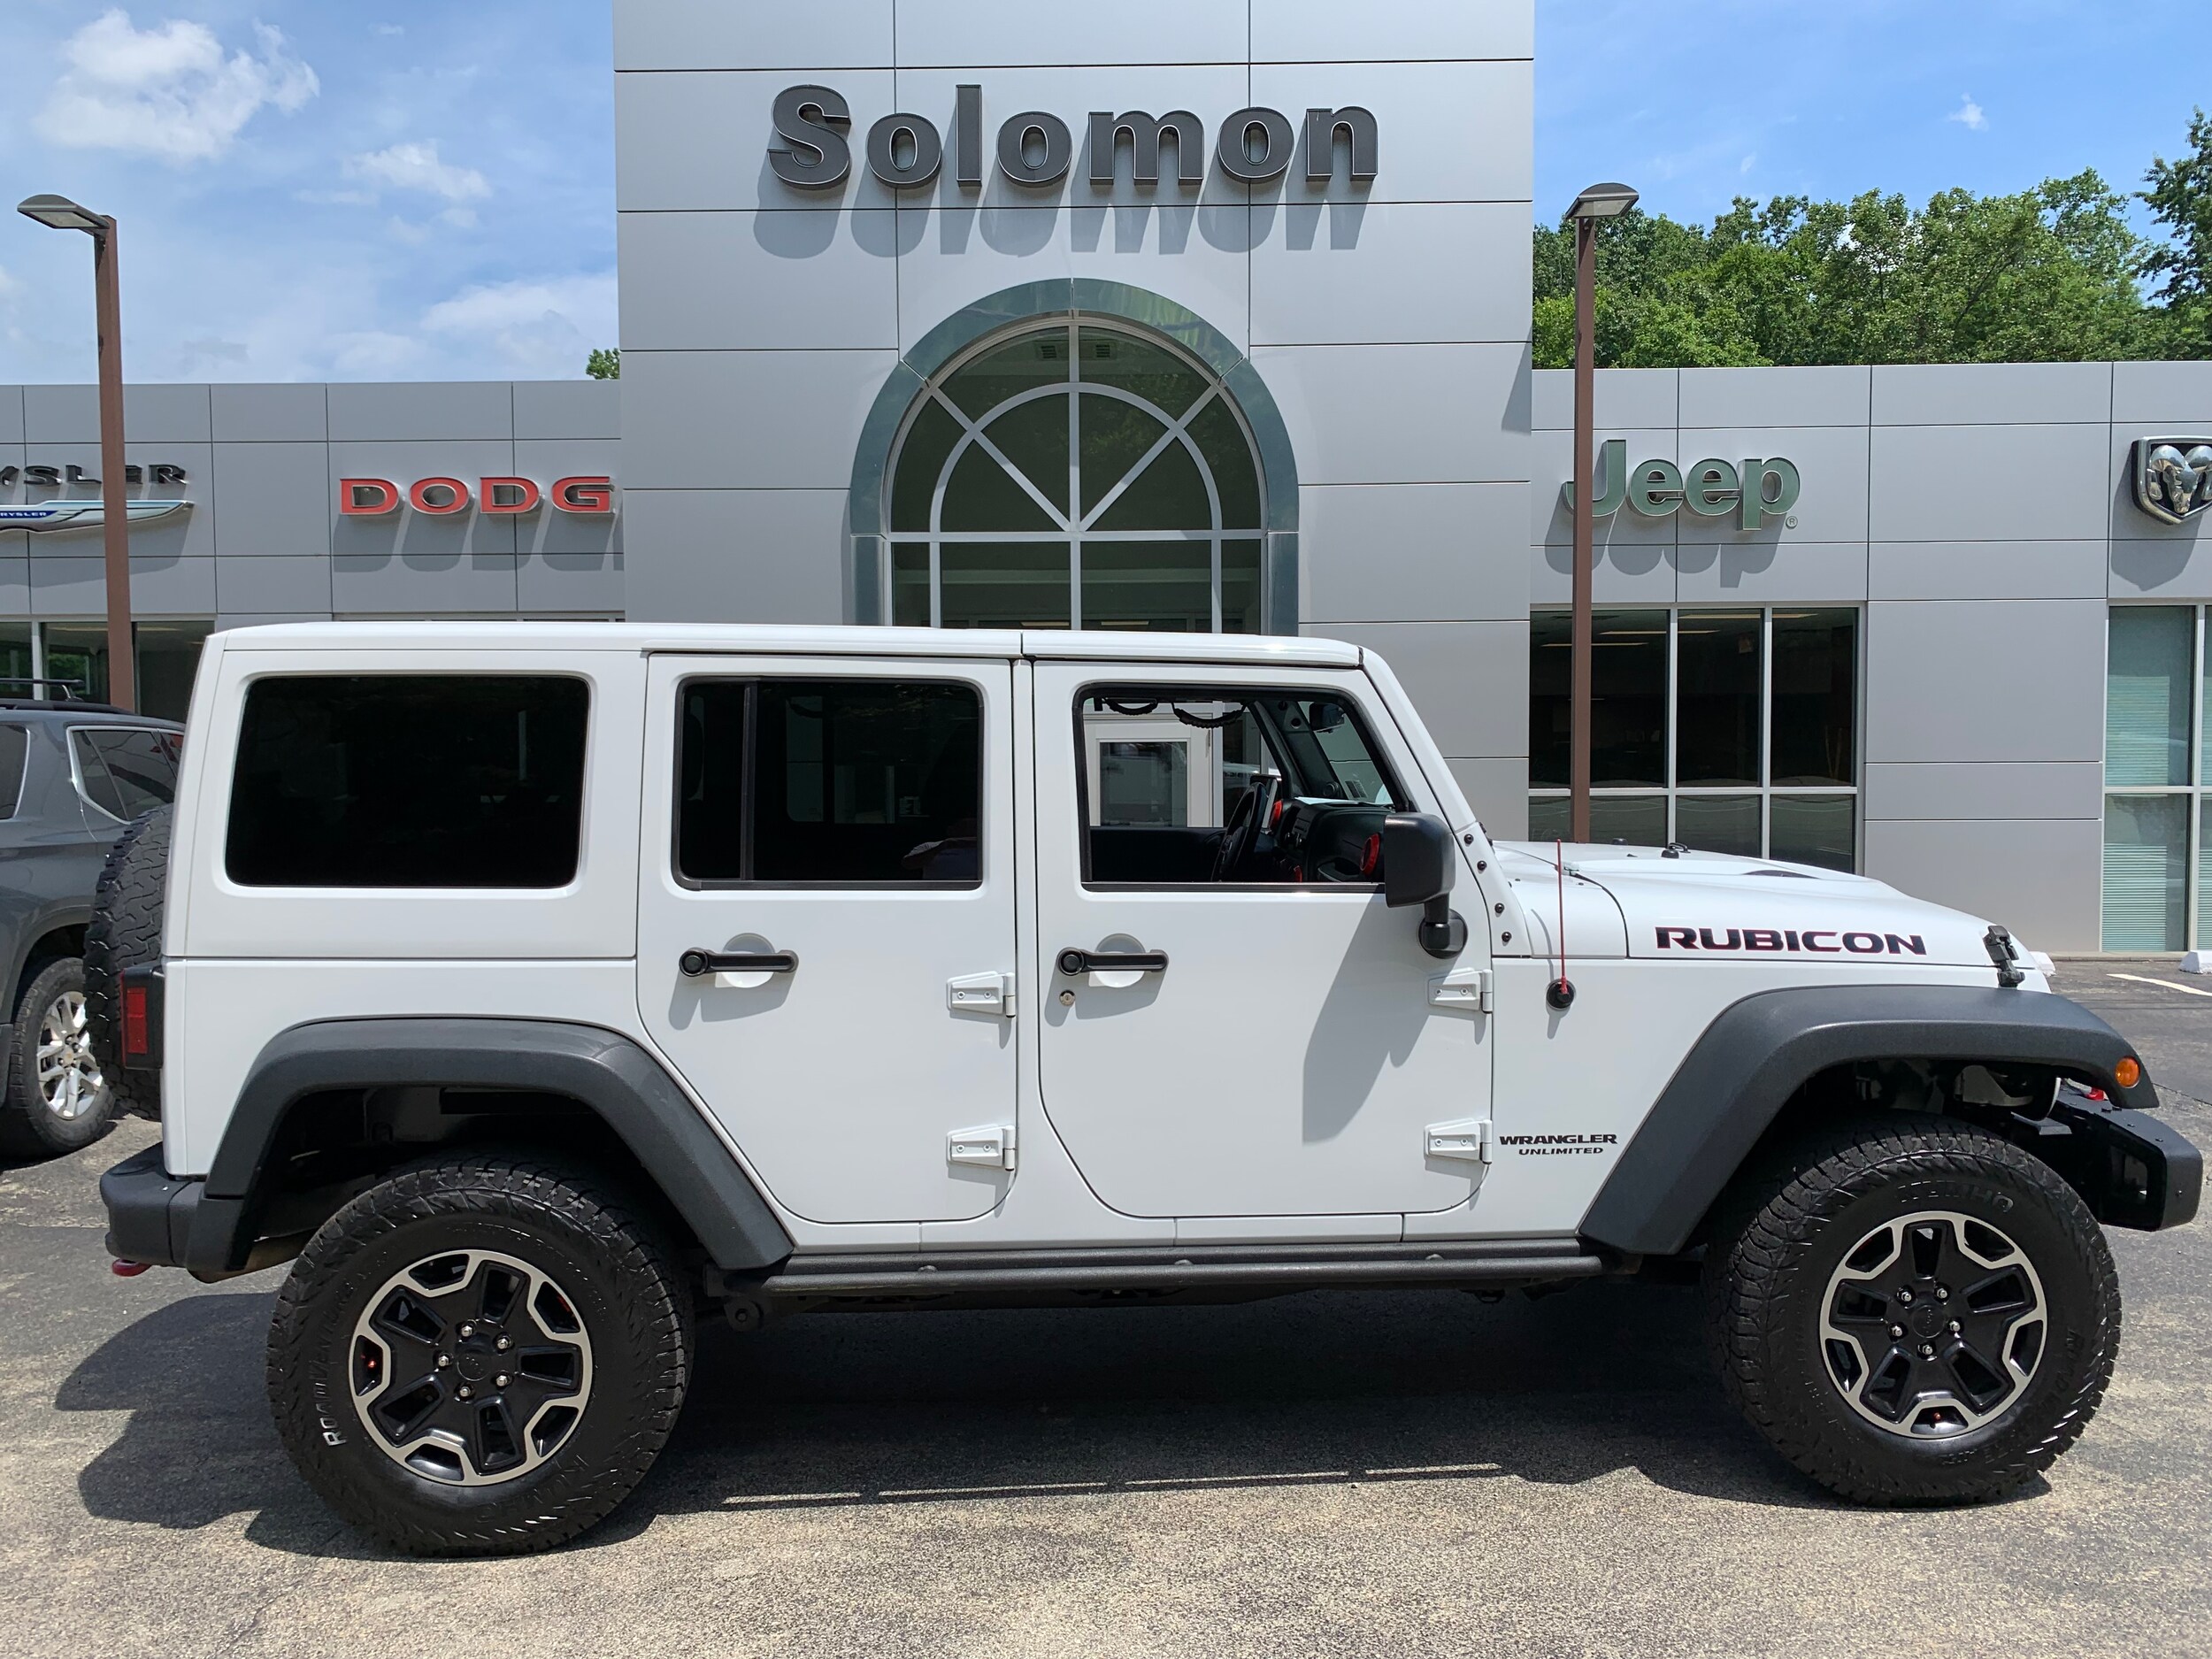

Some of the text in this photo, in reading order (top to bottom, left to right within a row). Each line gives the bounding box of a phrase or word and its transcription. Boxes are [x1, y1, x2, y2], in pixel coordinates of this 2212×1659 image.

[766, 84, 1379, 188] Solomon
[339, 475, 615, 515] DODG
[1563, 439, 1801, 531] Jeep
[1655, 926, 1927, 956] RUBICON
[1499, 1133, 1618, 1145] WRANGLER
[1518, 1147, 1604, 1156] UNLIMITED
